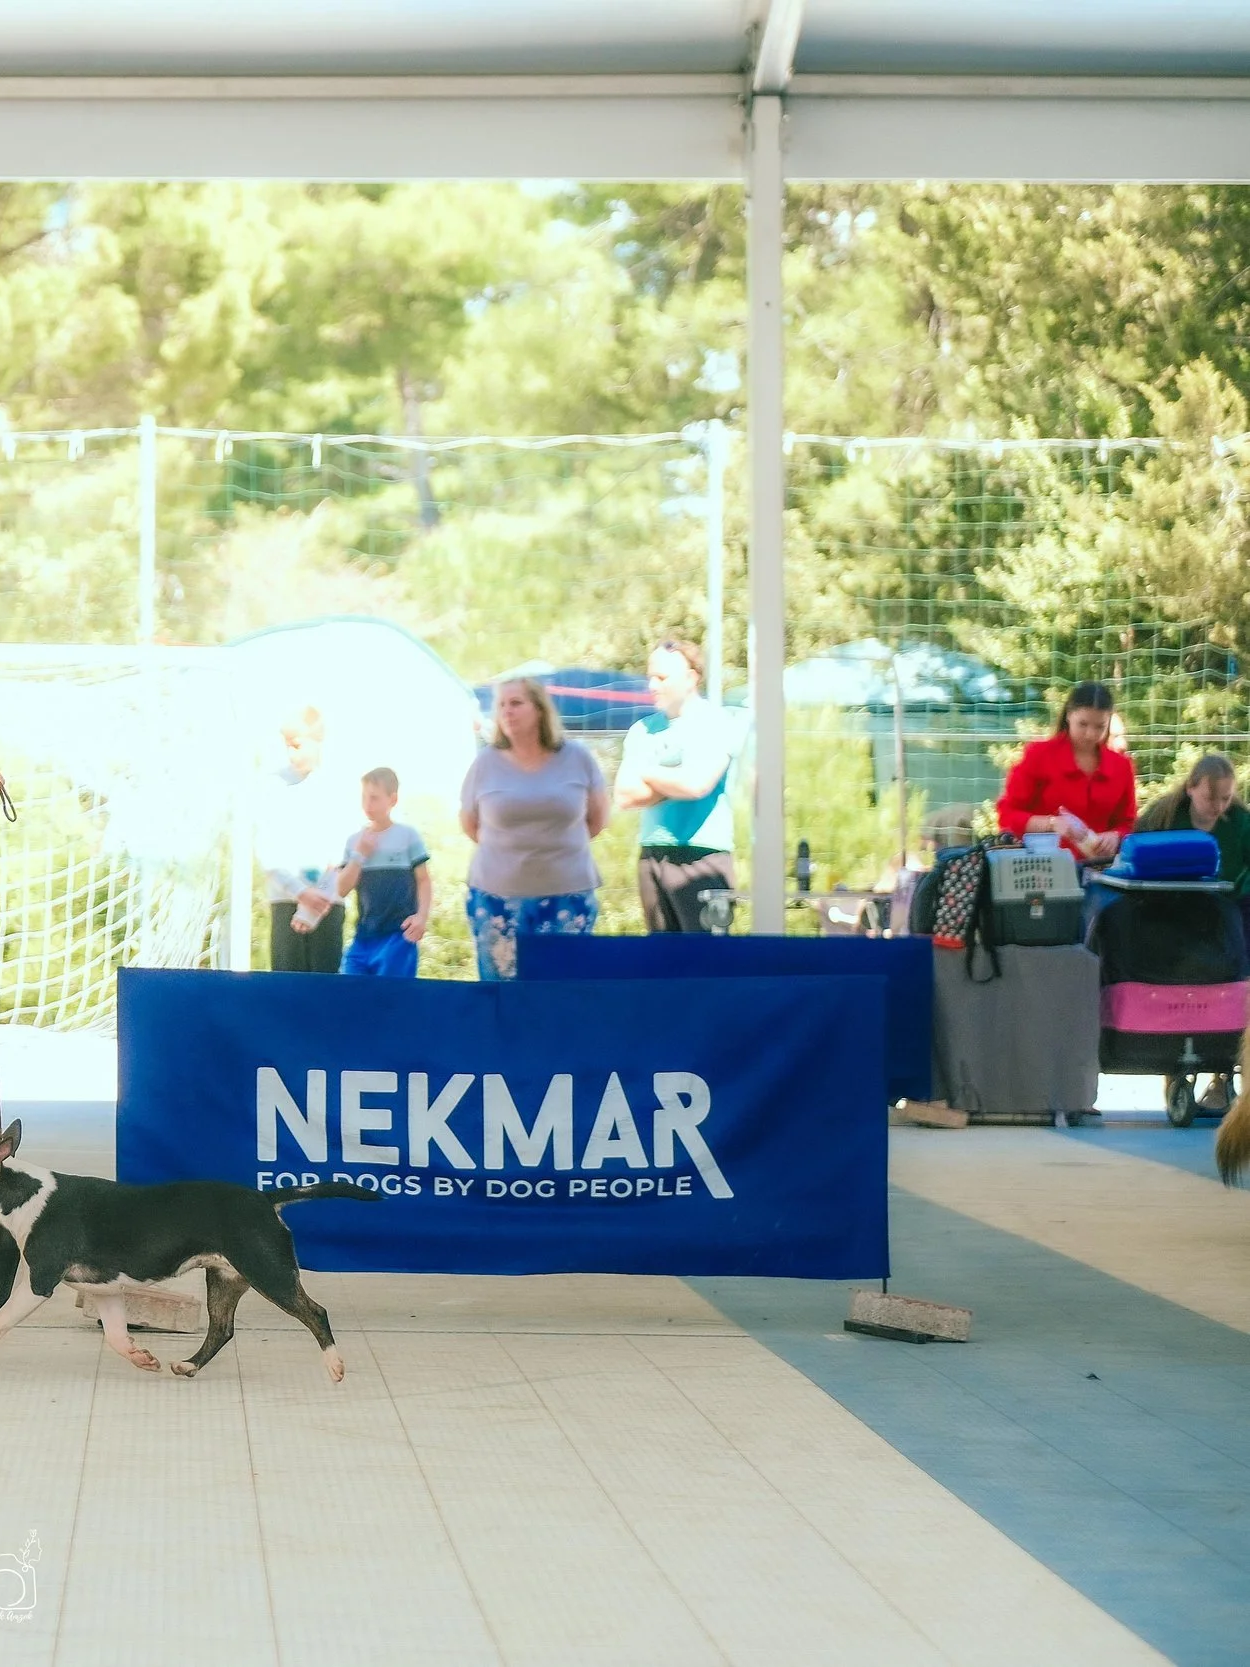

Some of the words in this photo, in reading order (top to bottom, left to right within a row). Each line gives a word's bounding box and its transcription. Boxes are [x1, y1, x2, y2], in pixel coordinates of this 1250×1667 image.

[256, 1067, 735, 1199] NEKMAR
[434, 1177, 474, 1196] BY
[486, 1179, 555, 1198] DOG
[569, 1176, 692, 1197] PEOPLE
